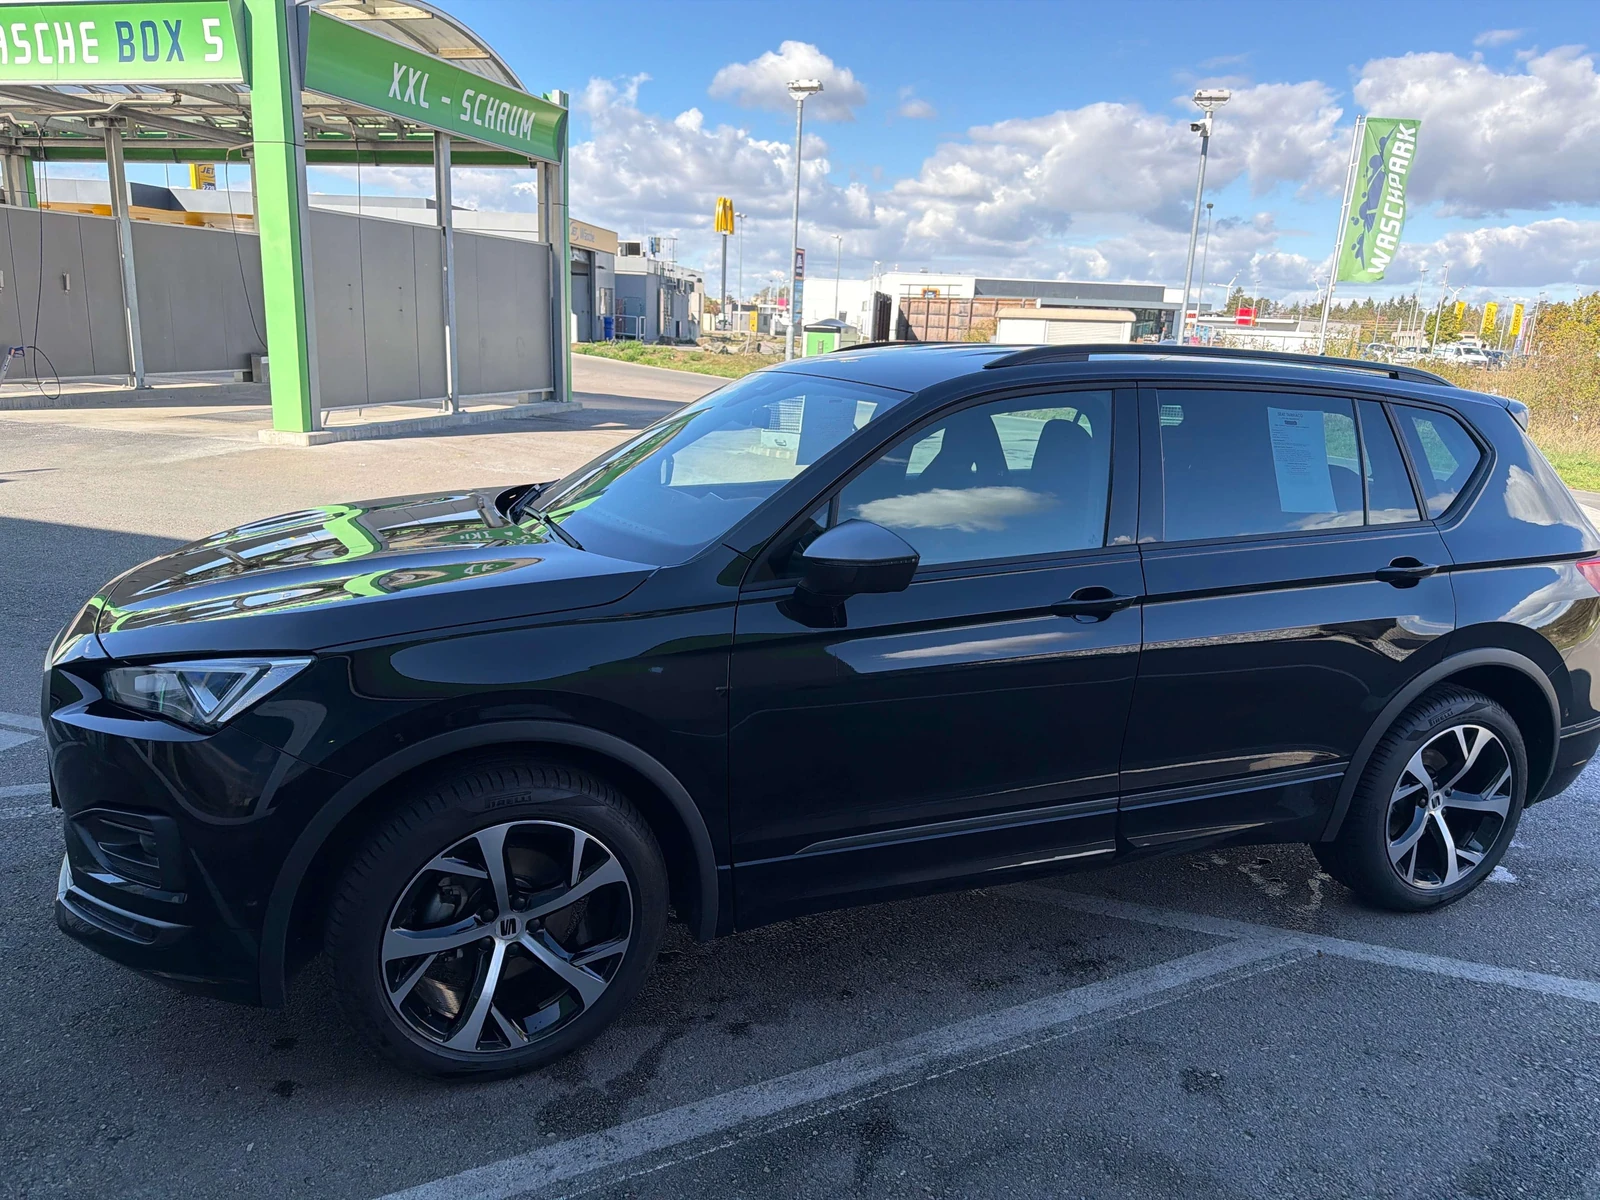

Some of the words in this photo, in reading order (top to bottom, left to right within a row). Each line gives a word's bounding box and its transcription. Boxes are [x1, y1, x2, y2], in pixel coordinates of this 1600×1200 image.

[115, 19, 185, 63] BOX
[202, 18, 223, 62] 5
[388, 62, 429, 109] XXL
[441, 96, 451, 104] -
[460, 88, 536, 141] SCHAUM
[201, 167, 214, 175] JET
[1367, 122, 1416, 274] WASCHPARK
[1428, 708, 1454, 727] PIRELLI
[484, 791, 532, 810] PIRELLI
